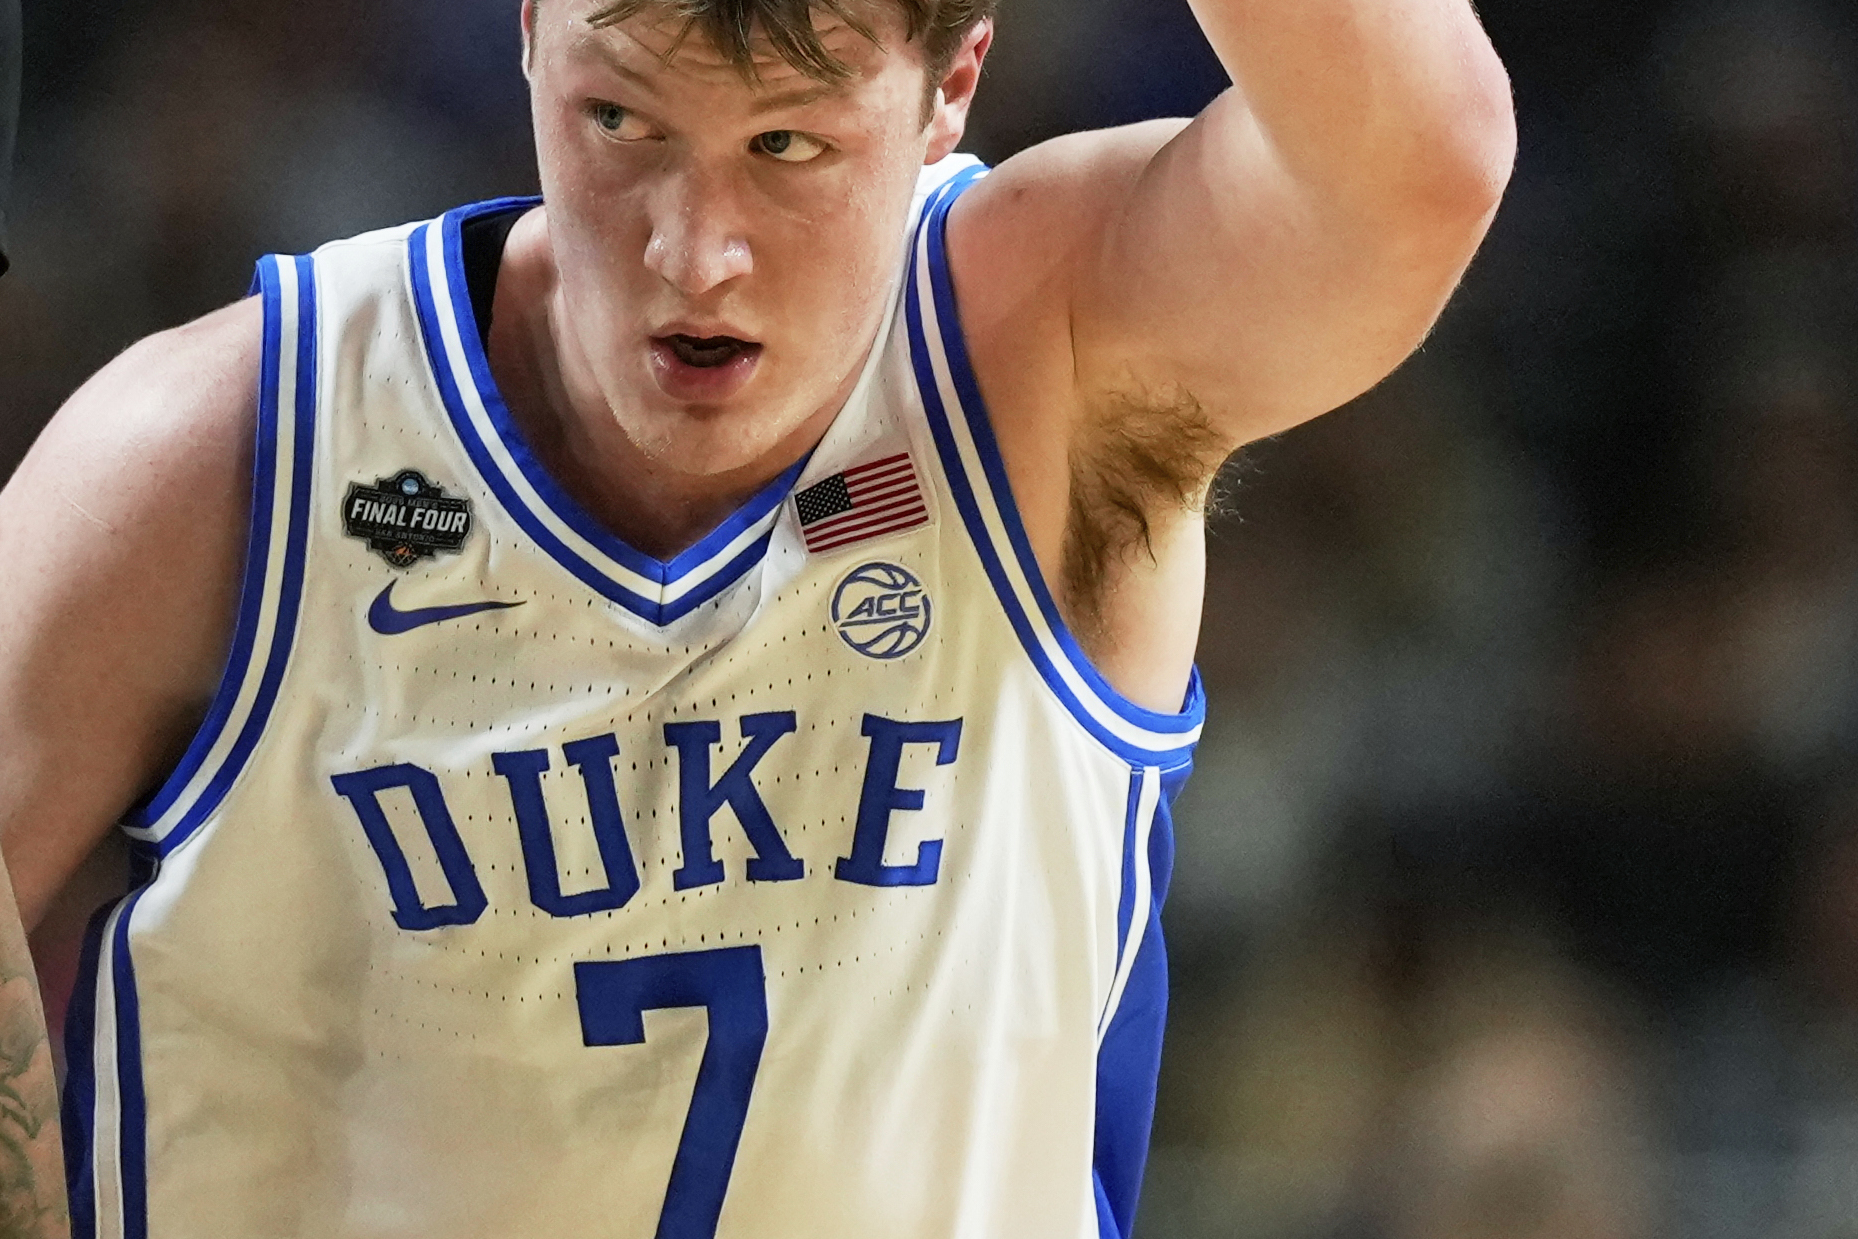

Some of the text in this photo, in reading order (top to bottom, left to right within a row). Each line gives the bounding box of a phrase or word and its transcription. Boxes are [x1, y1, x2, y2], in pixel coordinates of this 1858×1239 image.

[350, 497, 468, 533] FINAL FOUR
[846, 589, 922, 620] ACC
[330, 710, 963, 931] DUKE
[573, 944, 769, 1239] 7
